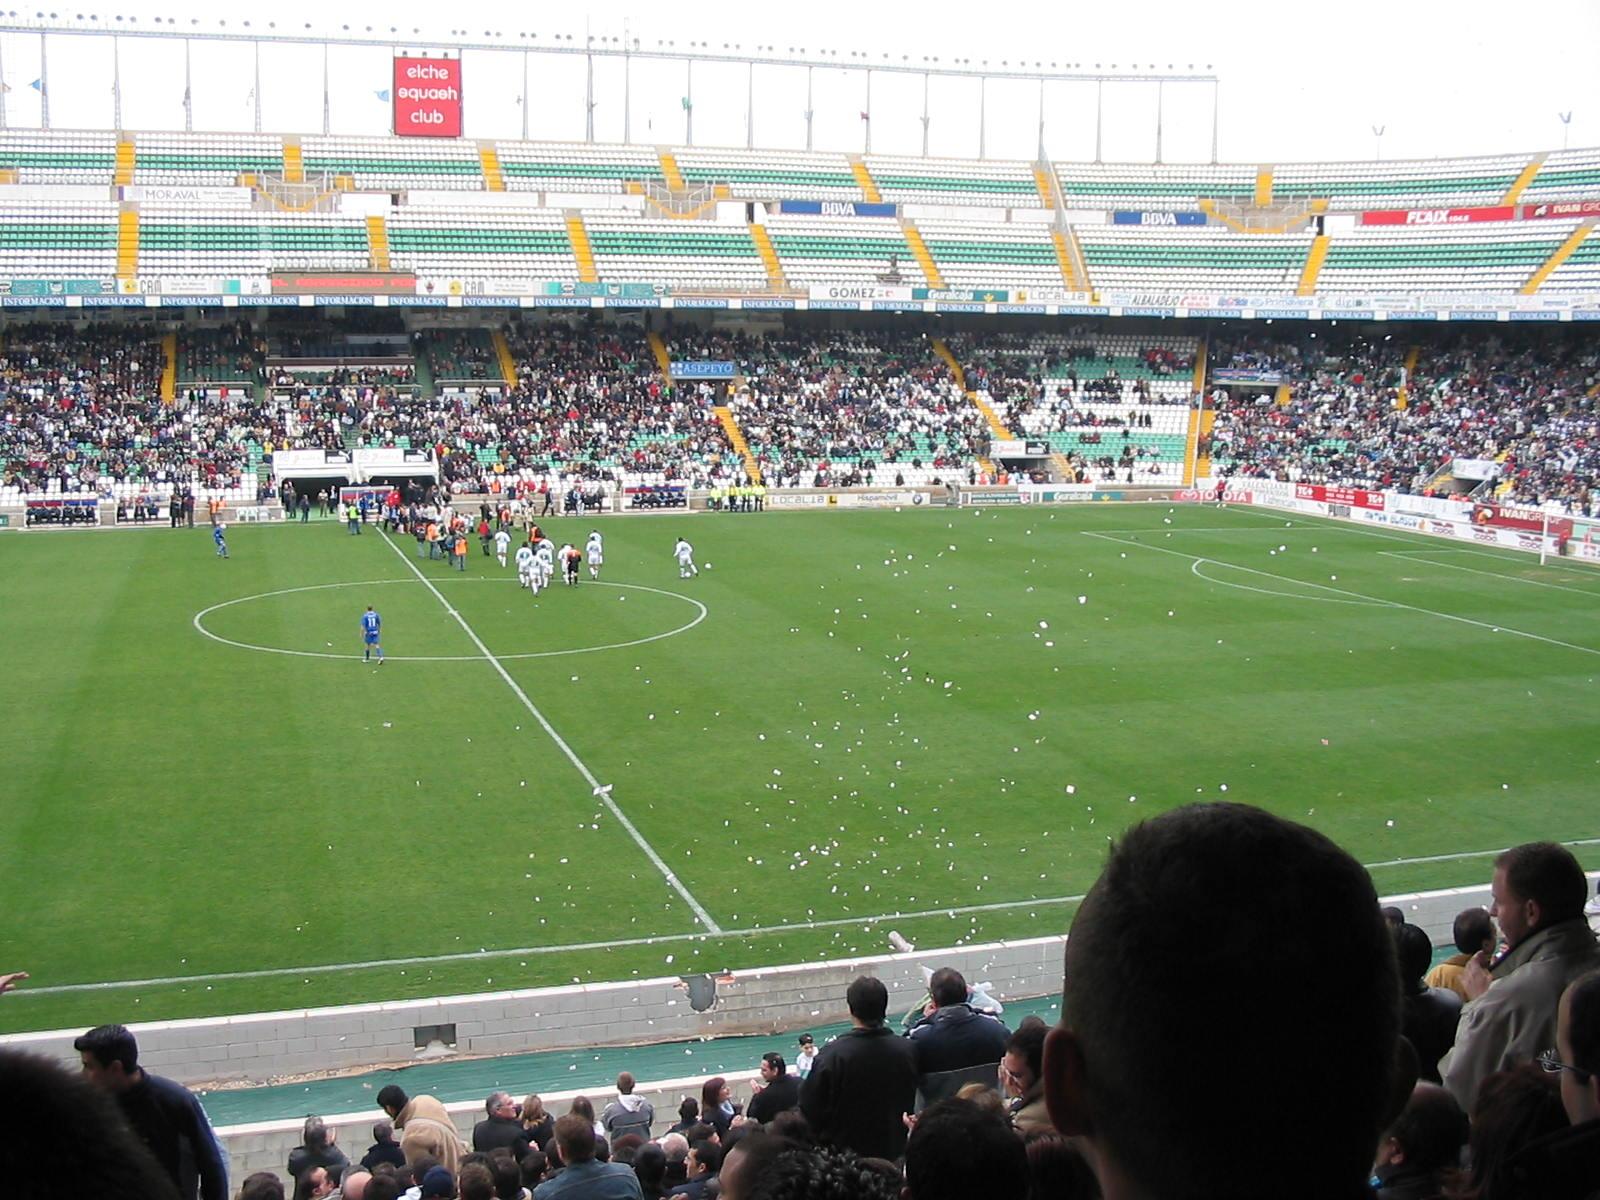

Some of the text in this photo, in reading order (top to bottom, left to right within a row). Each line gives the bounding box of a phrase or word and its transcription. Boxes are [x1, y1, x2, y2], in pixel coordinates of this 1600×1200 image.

[406, 64, 449, 80] elche
[410, 109, 444, 124] club
[145, 189, 201, 200] MORAVAL
[821, 202, 856, 215] BBVA
[1141, 212, 1177, 225] BBVA
[829, 287, 876, 298] GOMEZ
[4, 296, 64, 306] INFORMACION
[83, 296, 144, 306] INFORMACION
[162, 296, 221, 306] INFORMACION
[240, 296, 297, 306] INFORMACION
[315, 296, 373, 306] INFORMACION
[390, 296, 446, 306] INFORMACION
[463, 296, 518, 306] INFORMACION
[536, 297, 590, 307] INFORMACION
[683, 363, 733, 373] ASEPEYO
[1499, 508, 1560, 524] IVANGRUP
[368, 617, 376, 627] 11
